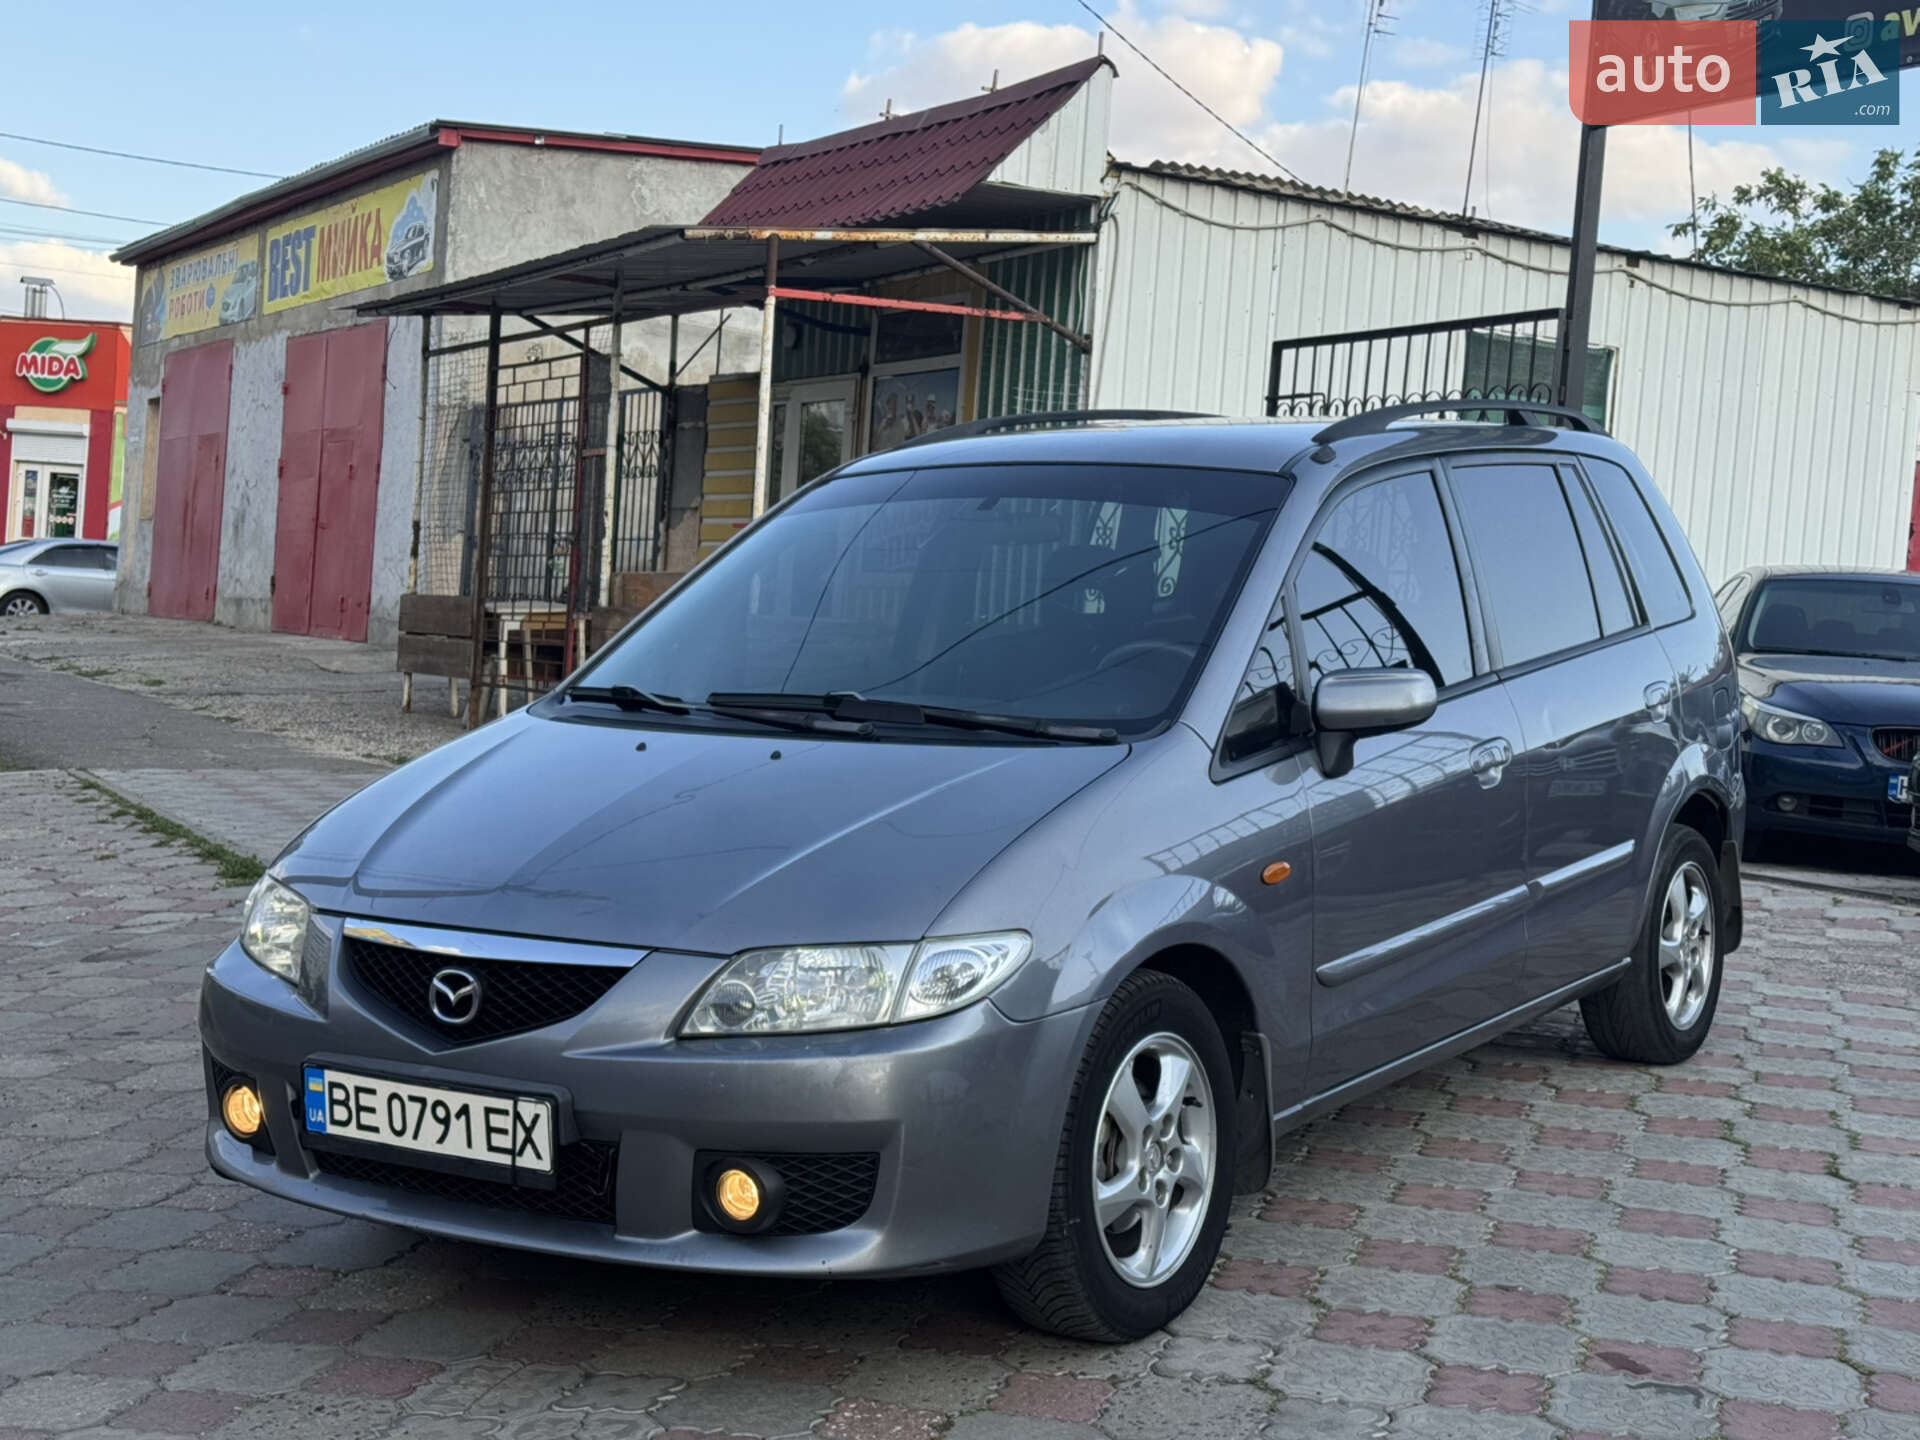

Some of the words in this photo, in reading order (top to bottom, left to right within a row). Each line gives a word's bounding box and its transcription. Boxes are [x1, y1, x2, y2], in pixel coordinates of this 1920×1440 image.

[267, 224, 317, 302] BEST
[16, 352, 83, 380] MIDA
[309, 1107, 326, 1123] UA
